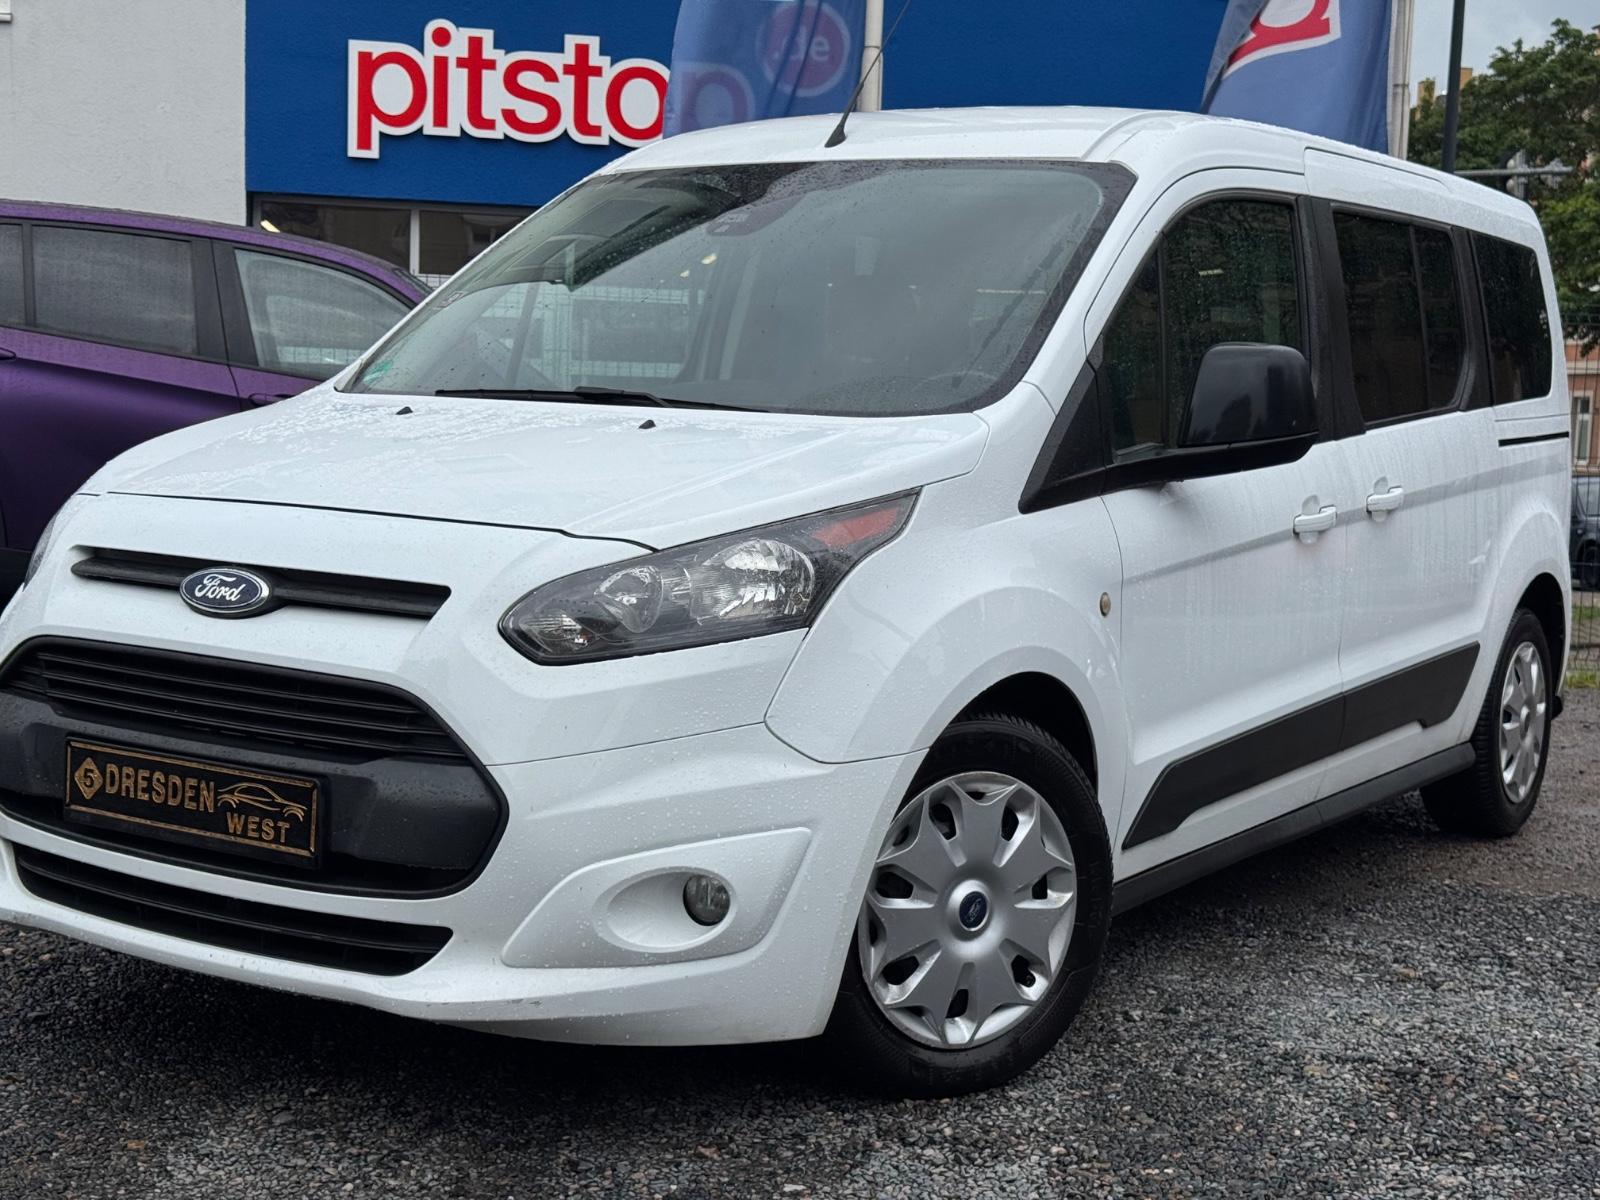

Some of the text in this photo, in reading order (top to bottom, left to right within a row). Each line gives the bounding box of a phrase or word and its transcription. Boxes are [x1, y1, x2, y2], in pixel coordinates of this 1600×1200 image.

[195, 574, 246, 601] Ford
[105, 763, 215, 813] DRESDEN
[226, 812, 290, 843] WEST
